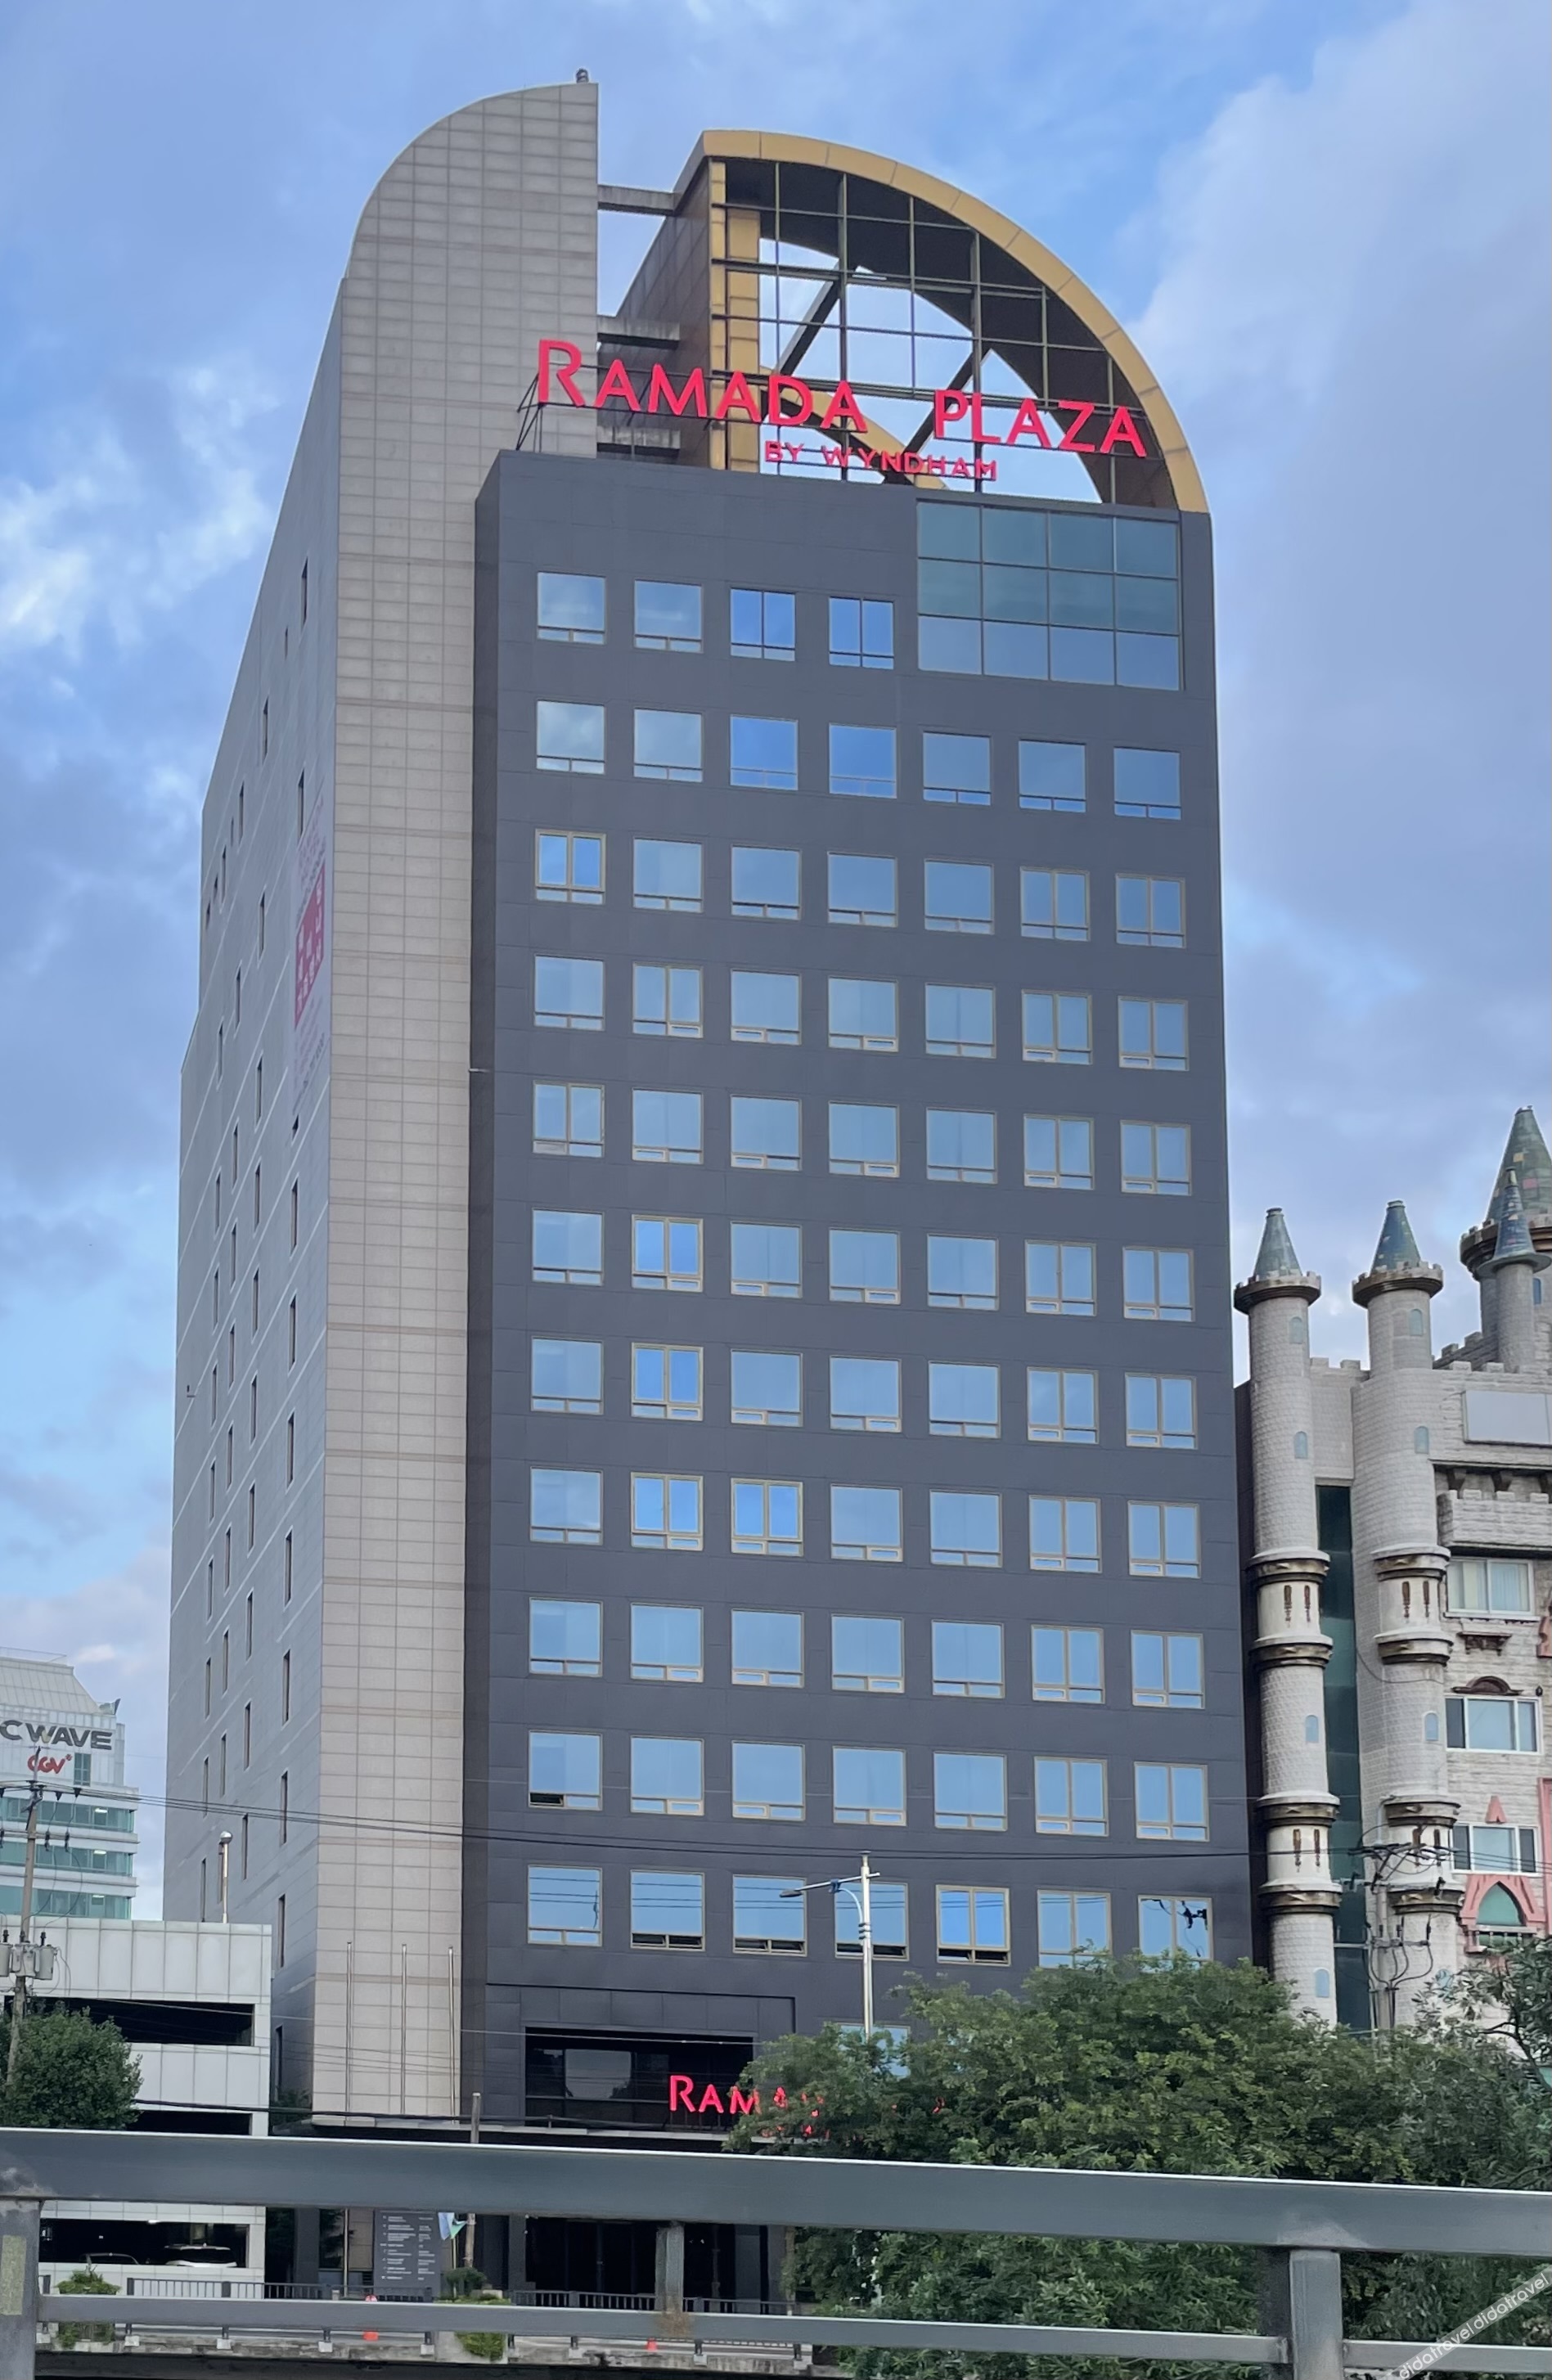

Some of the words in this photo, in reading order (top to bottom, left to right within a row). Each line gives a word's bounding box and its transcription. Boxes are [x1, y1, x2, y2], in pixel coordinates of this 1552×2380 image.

[538, 339, 867, 433] RAMADA
[933, 389, 1146, 457] PLAZA
[764, 440, 804, 463] BY
[821, 444, 997, 482] WYNDHAM
[27, 1754, 65, 1775] CGV
